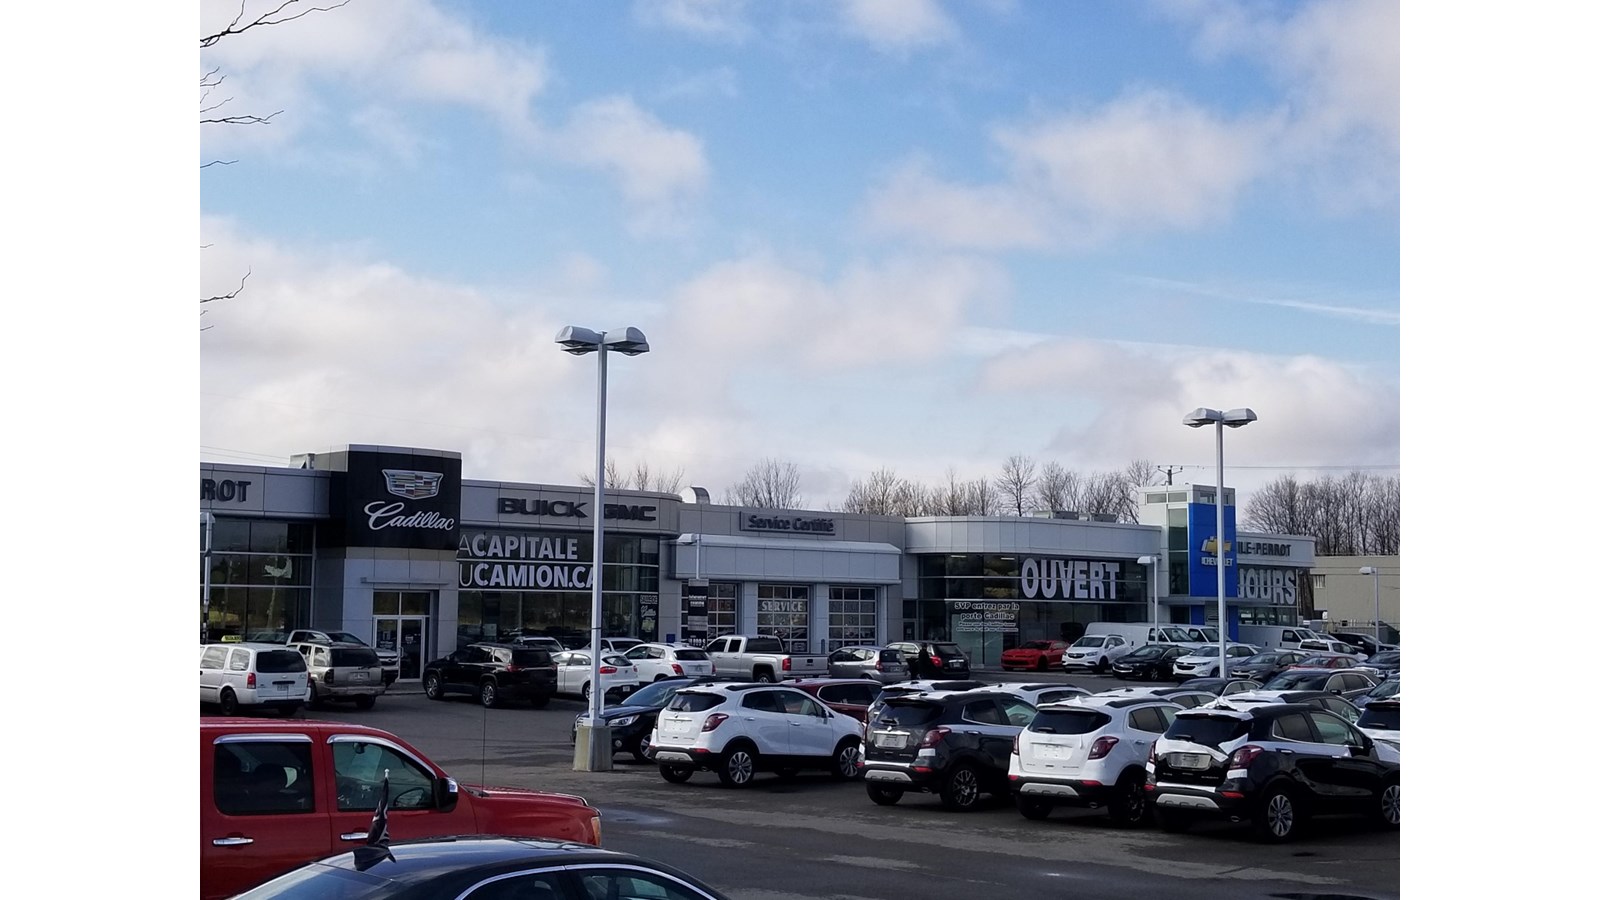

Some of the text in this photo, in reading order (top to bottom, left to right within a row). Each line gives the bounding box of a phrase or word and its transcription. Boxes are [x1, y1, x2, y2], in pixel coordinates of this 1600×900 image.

[201, 478, 252, 502] ROT
[363, 501, 455, 530] Cadillac
[498, 498, 657, 521] BUICK GMC
[748, 515, 790, 529] Service
[1201, 556, 1233, 567] CHEVLET
[1021, 558, 1120, 599] OUVERT
[1238, 568, 1296, 605] JOURS
[762, 601, 803, 612] SERVICE
[954, 601, 1020, 611] SVP entrez par la
[960, 611, 1015, 621] porte Cadillac
